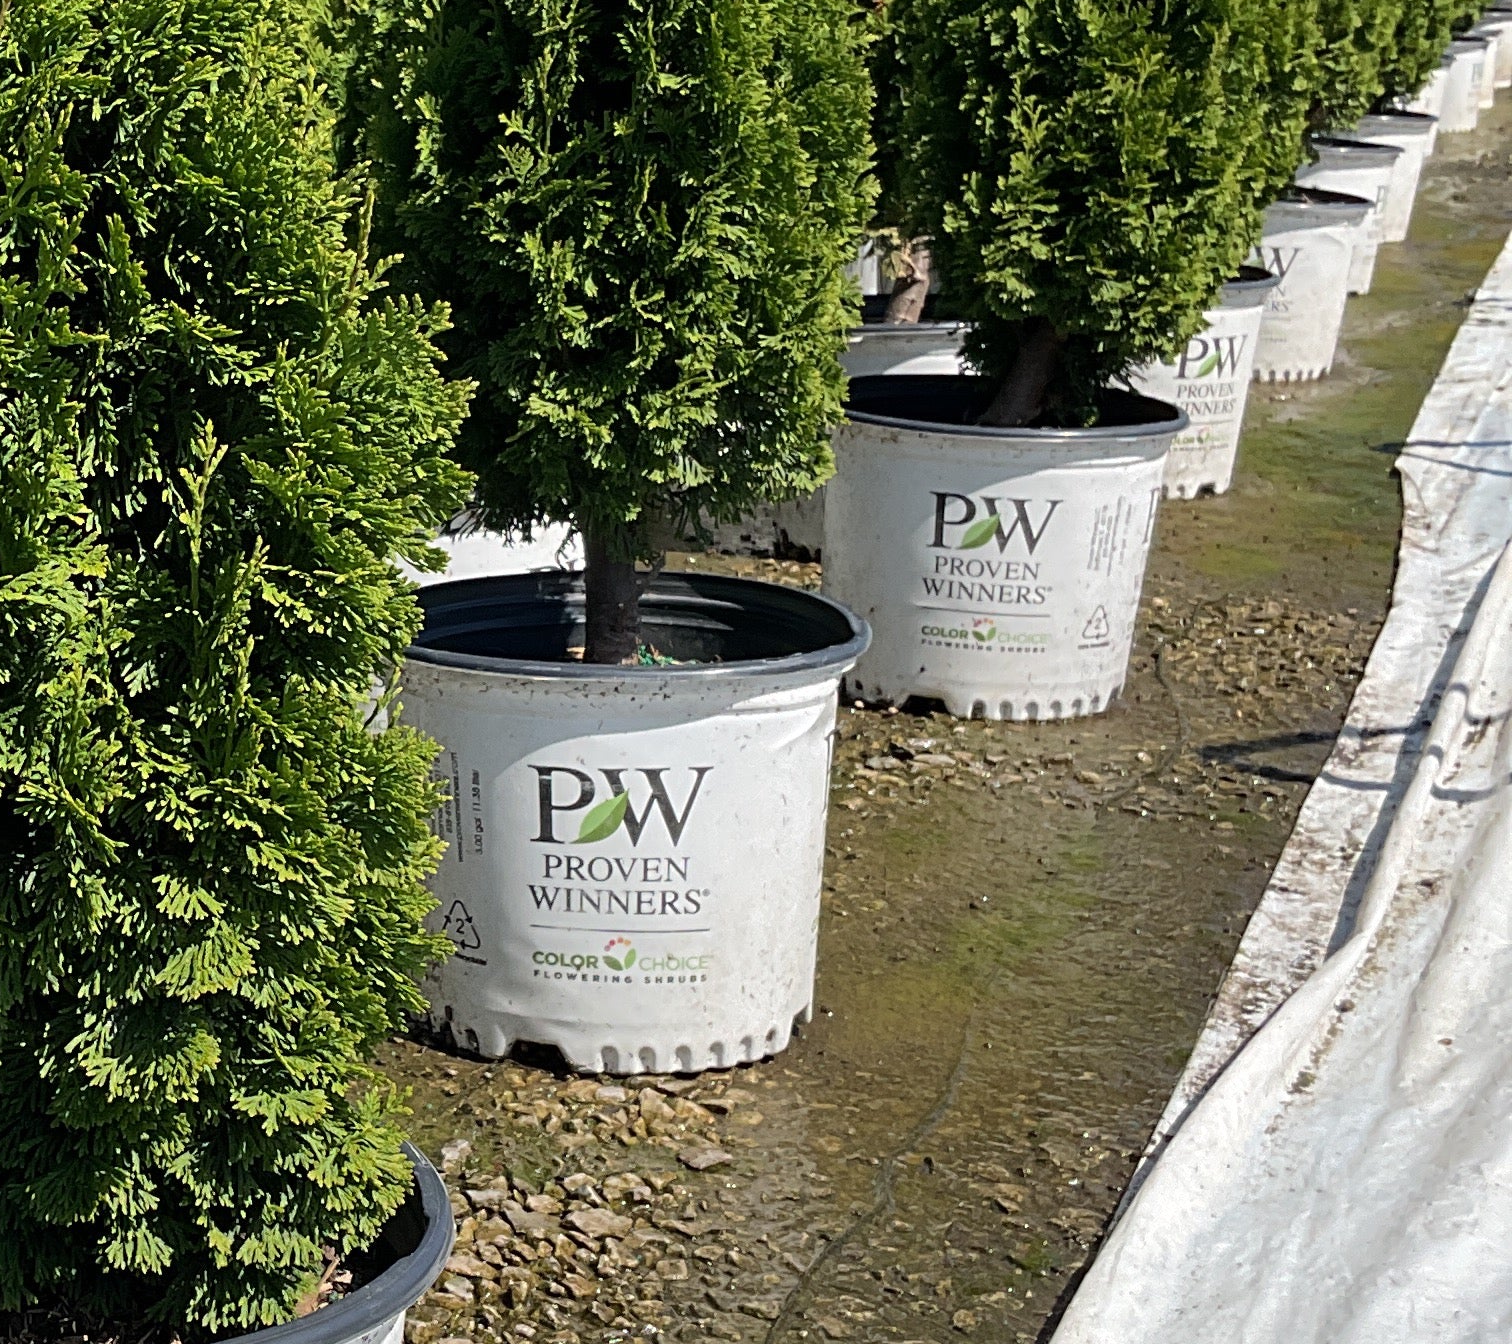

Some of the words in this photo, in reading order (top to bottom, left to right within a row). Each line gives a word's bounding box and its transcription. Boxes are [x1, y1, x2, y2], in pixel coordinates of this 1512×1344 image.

[1173, 334, 1249, 379] PW
[1177, 382, 1235, 399] PROVEN
[1182, 398, 1236, 416] INNERS
[926, 491, 1064, 555] PW
[934, 555, 1041, 581] PROVEN
[921, 625, 969, 639] COLOR
[527, 763, 714, 848] PW
[541, 854, 691, 883] PROVEN
[455, 917, 465, 935] 2
[532, 950, 599, 969] COLOR
[639, 954, 709, 972] CHOICE
[533, 969, 633, 984] FLOWERING
[644, 973, 708, 984] SHRUBS
